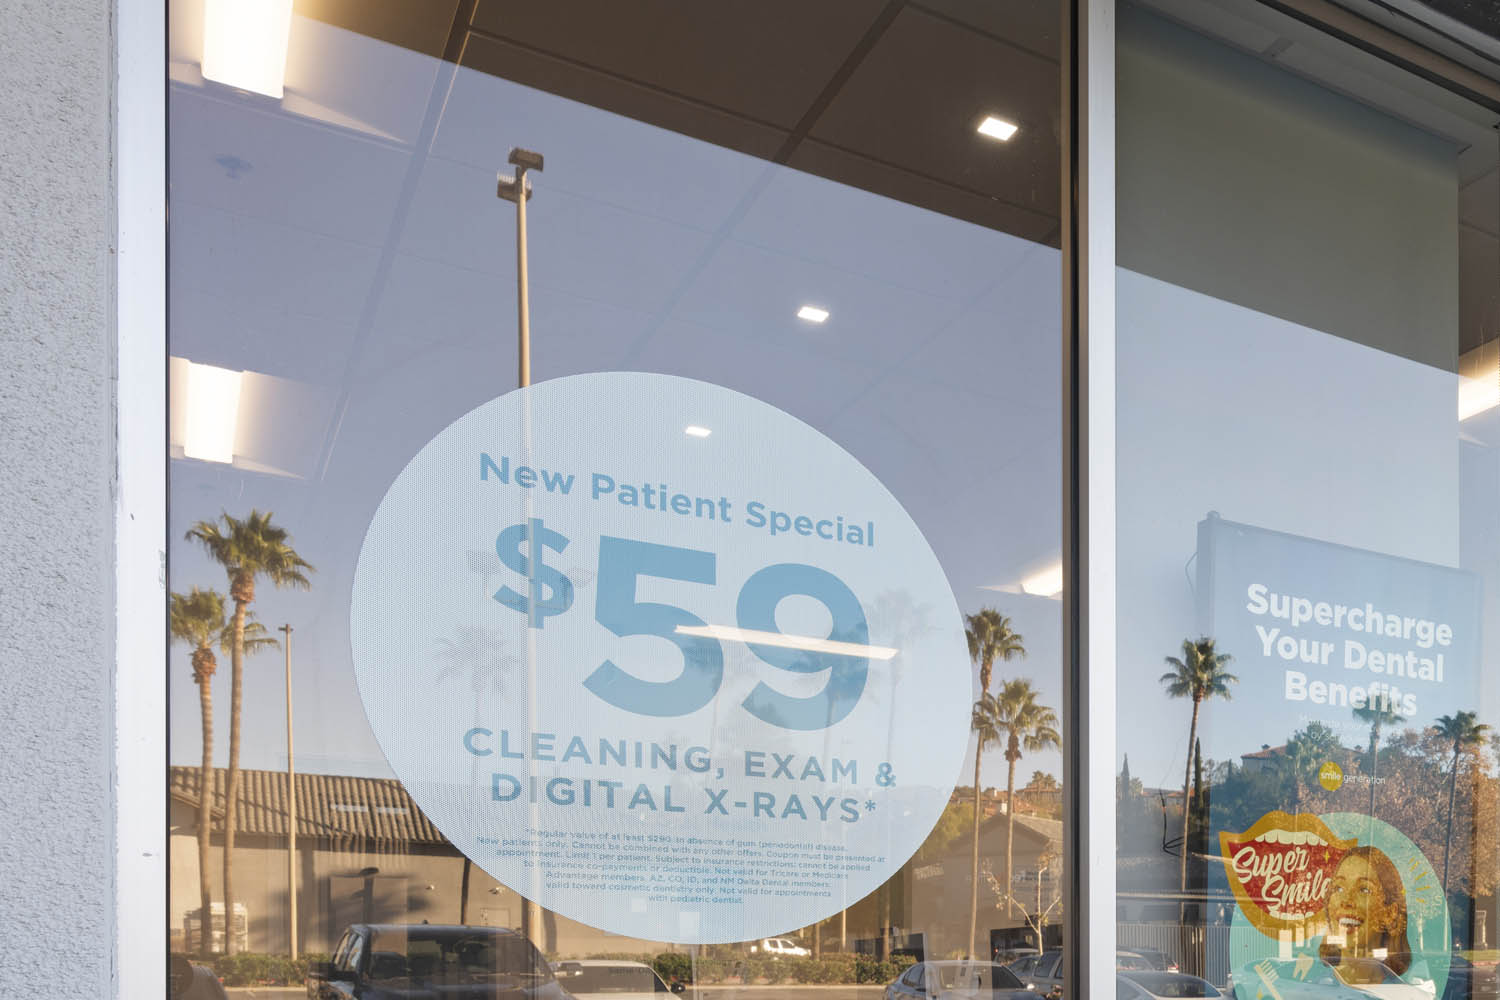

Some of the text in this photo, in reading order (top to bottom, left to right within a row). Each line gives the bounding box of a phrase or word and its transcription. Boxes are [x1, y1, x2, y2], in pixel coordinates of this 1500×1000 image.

[480, 452, 875, 548] New Patient Special
[493, 517, 871, 732] $59
[1246, 583, 1453, 648] Supercharge
[1255, 625, 1444, 683] Your Dental
[1285, 671, 1417, 717] Benefits
[463, 727, 897, 789] CLEANING, EXAM &
[1343, 774, 1386, 786] generation
[491, 773, 685, 814] DIGITAL
[1231, 845, 1310, 884] Super
[1261, 868, 1333, 912] Smile
